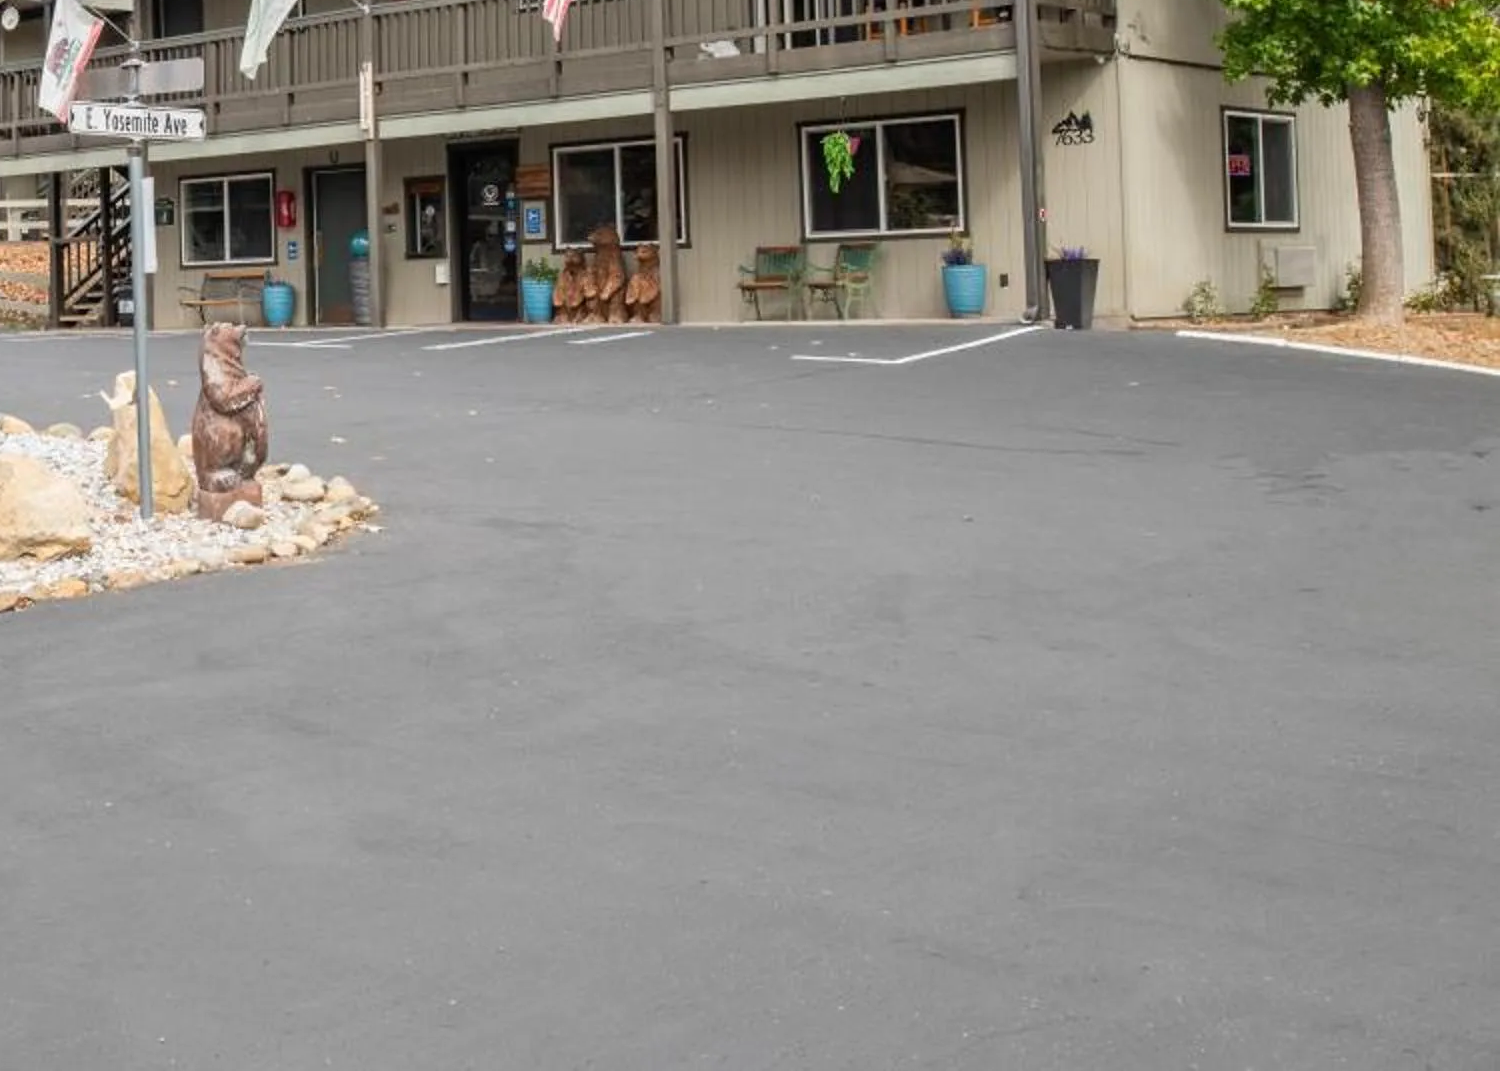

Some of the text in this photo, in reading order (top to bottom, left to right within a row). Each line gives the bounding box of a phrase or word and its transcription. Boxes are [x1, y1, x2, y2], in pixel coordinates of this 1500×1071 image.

[86, 107, 187, 135] E. Yosemite Ave
[1054, 129, 1095, 146] 7633
